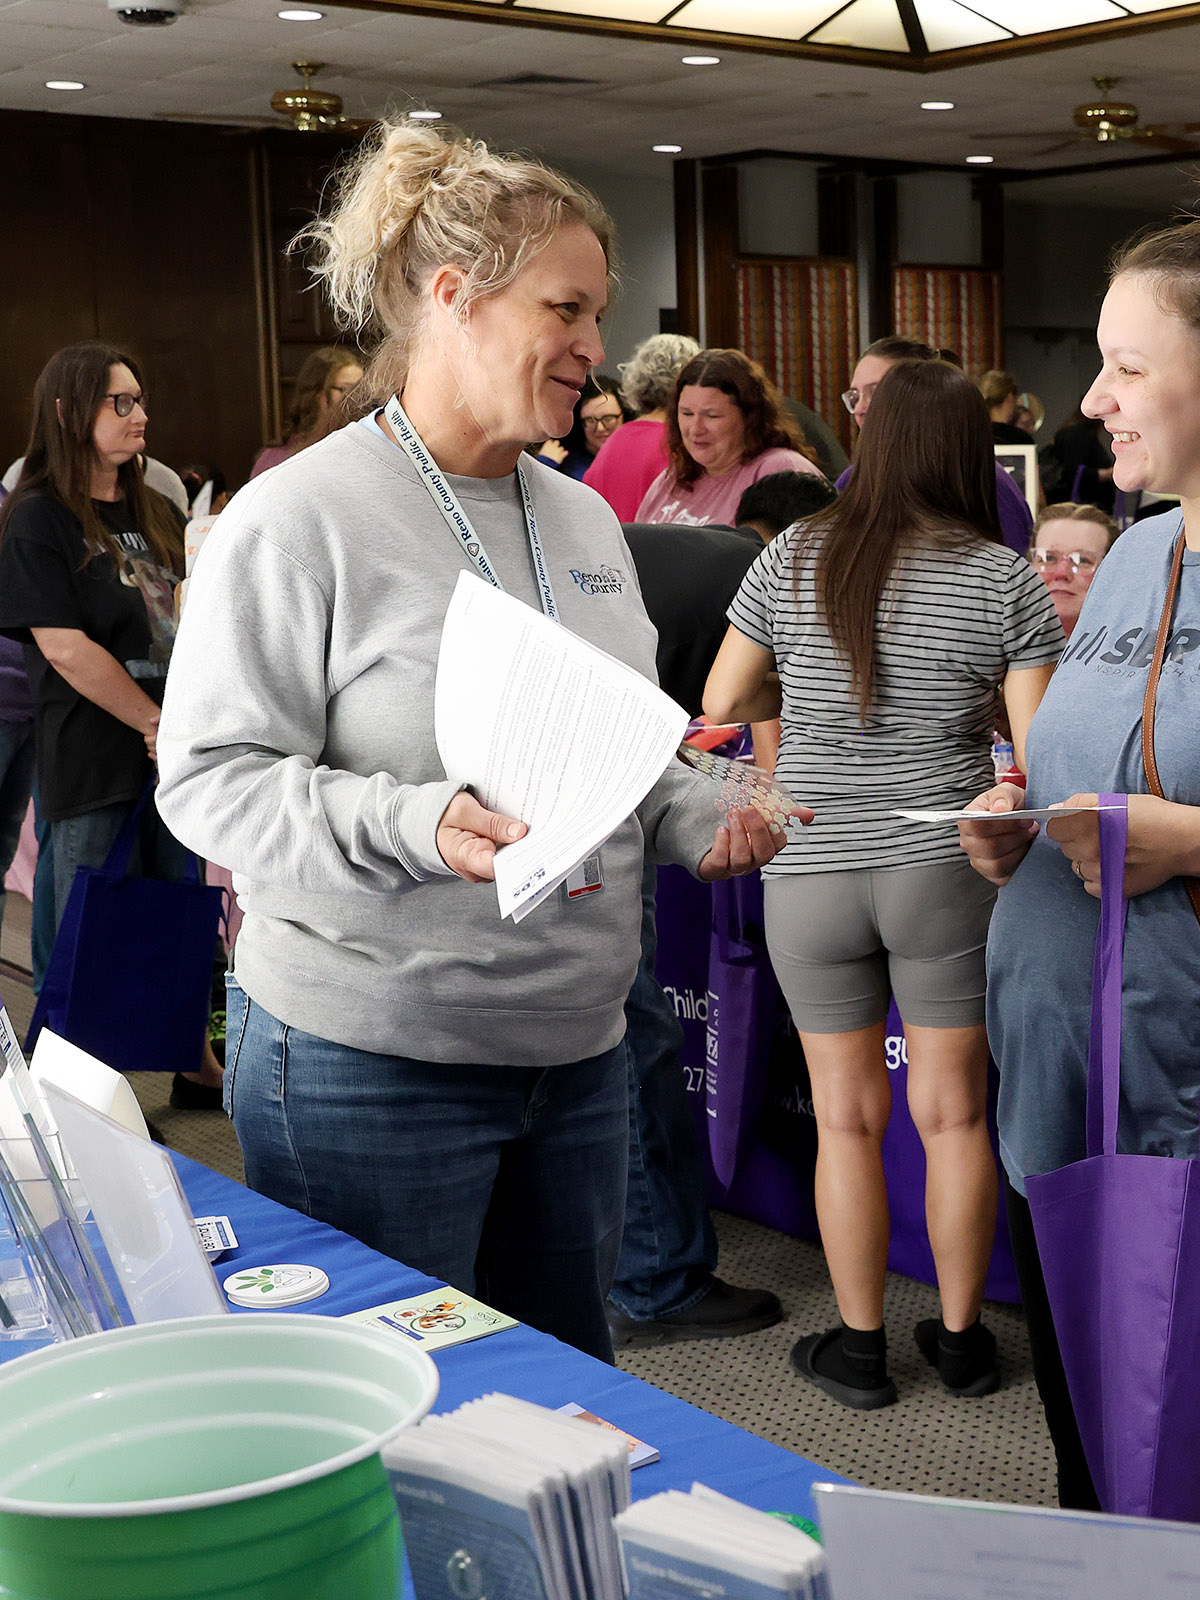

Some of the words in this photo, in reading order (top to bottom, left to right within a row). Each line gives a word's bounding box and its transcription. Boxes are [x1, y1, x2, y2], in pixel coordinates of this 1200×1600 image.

[391, 410, 413, 441] Health
[410, 440, 434, 475] Public
[430, 475, 455, 512] County
[452, 511, 472, 541] Reno
[529, 518, 539, 545] Reno
[535, 546, 547, 583] County
[542, 583, 555, 618] Public
[569, 569, 602, 583] Reno
[580, 581, 623, 596] County
